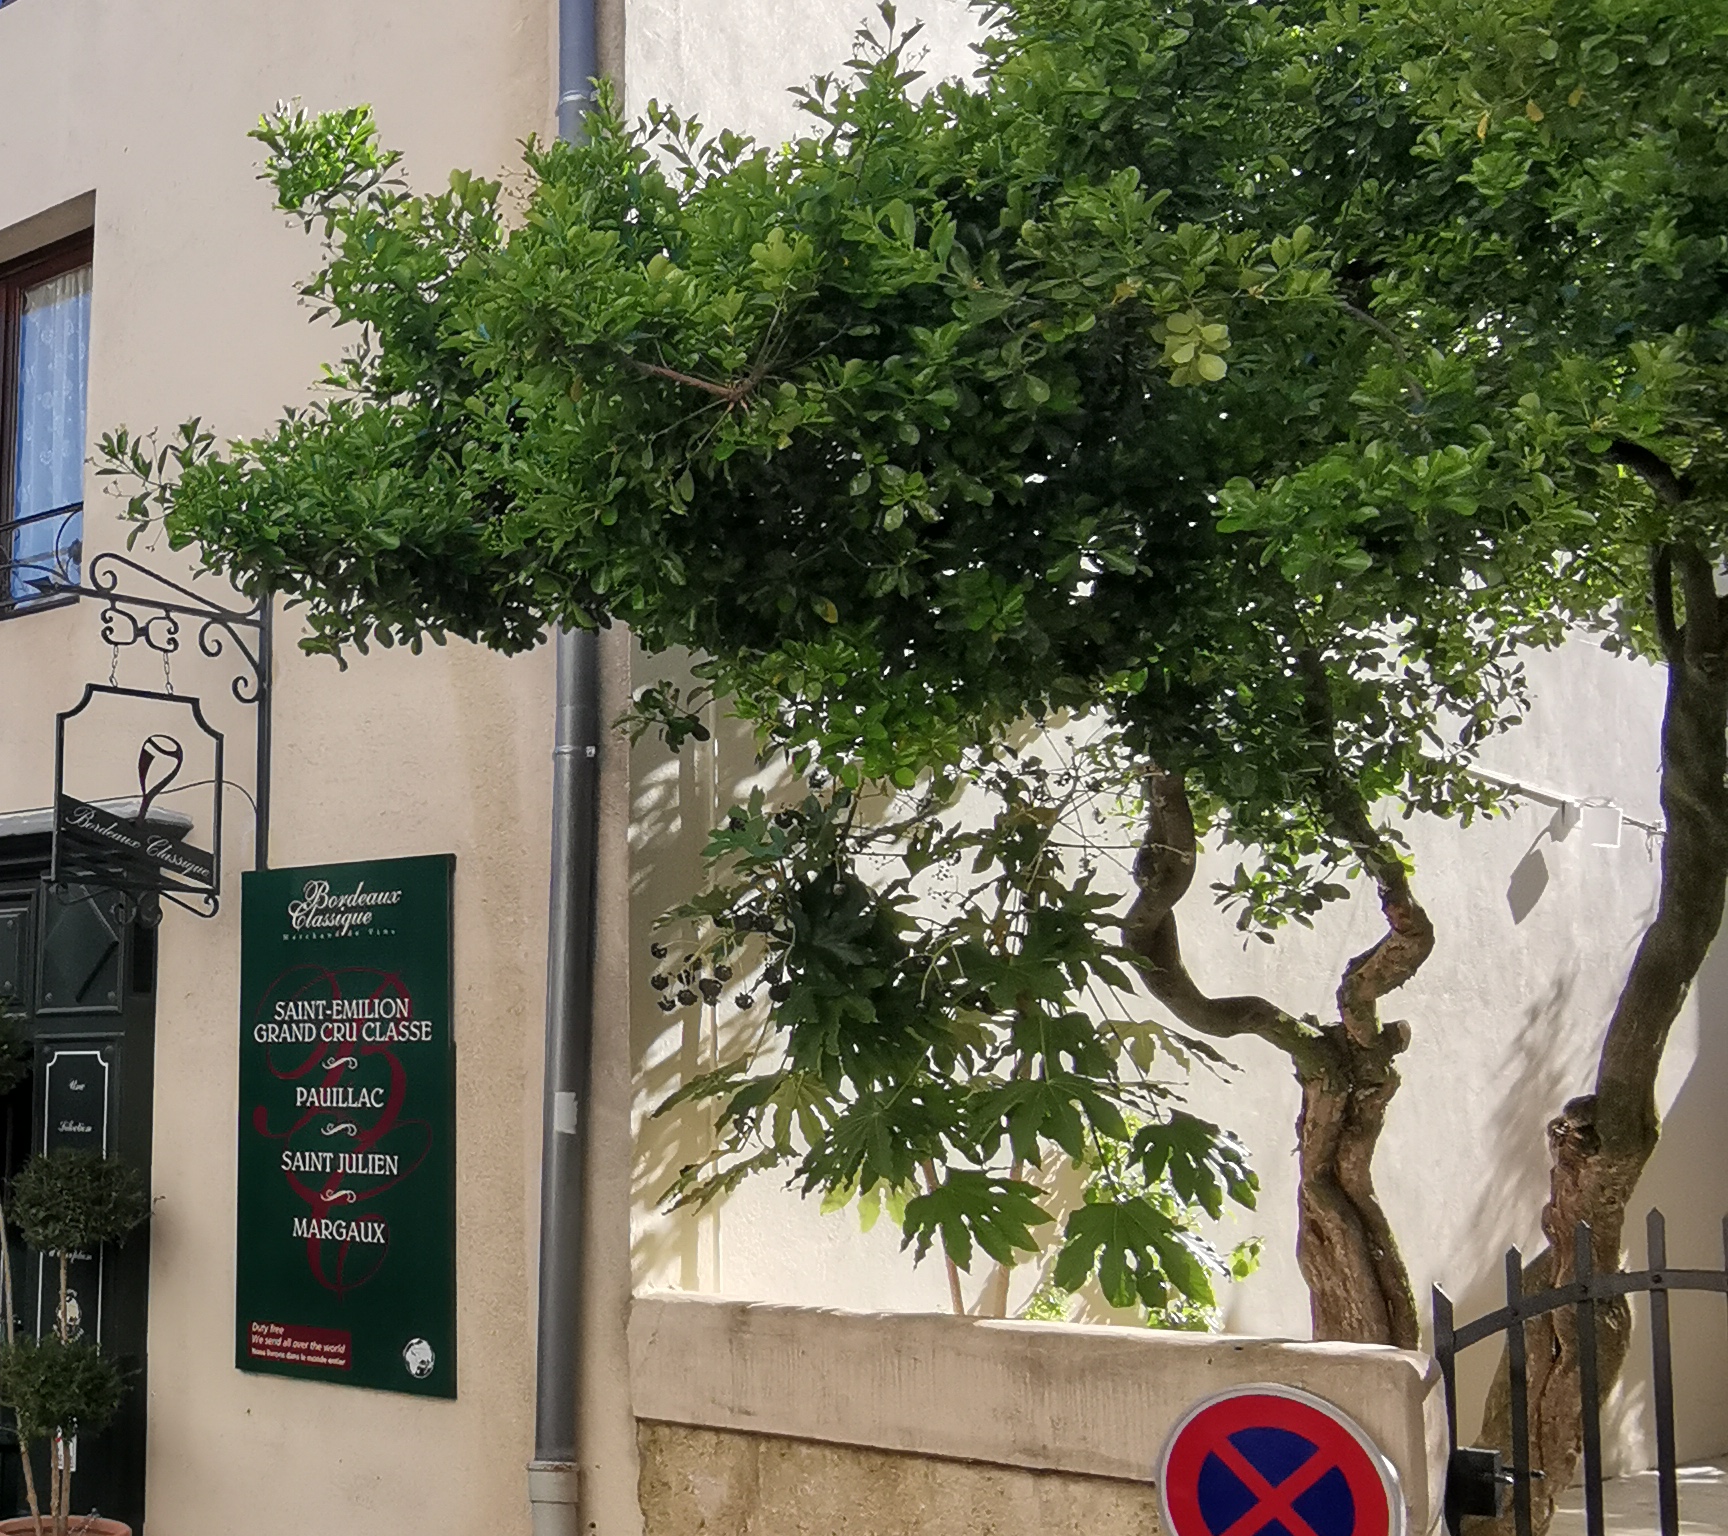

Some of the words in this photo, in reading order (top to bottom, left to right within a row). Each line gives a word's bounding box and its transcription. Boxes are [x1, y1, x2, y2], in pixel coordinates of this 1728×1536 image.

[65, 806, 141, 850] Bordeaux
[145, 834, 211, 876] Classique
[294, 879, 403, 910] Bordeaux
[288, 901, 373, 937] Classique
[273, 997, 410, 1022] SAINT-EMILION
[252, 1020, 318, 1044] GRAND
[321, 1020, 357, 1042] CRU
[362, 1020, 433, 1042] CLASSE
[295, 1085, 385, 1109] PAUILLAC
[280, 1150, 334, 1174] SAINT
[335, 1152, 399, 1176] JULIEN
[292, 1216, 387, 1245] MARGAUX
[252, 1321, 269, 1335] Duty
[252, 1333, 264, 1344] We
[264, 1335, 282, 1346] send
[282, 1337, 292, 1348] all
[292, 1340, 309, 1349] over
[310, 1341, 323, 1351] the
[323, 1343, 346, 1354] world
